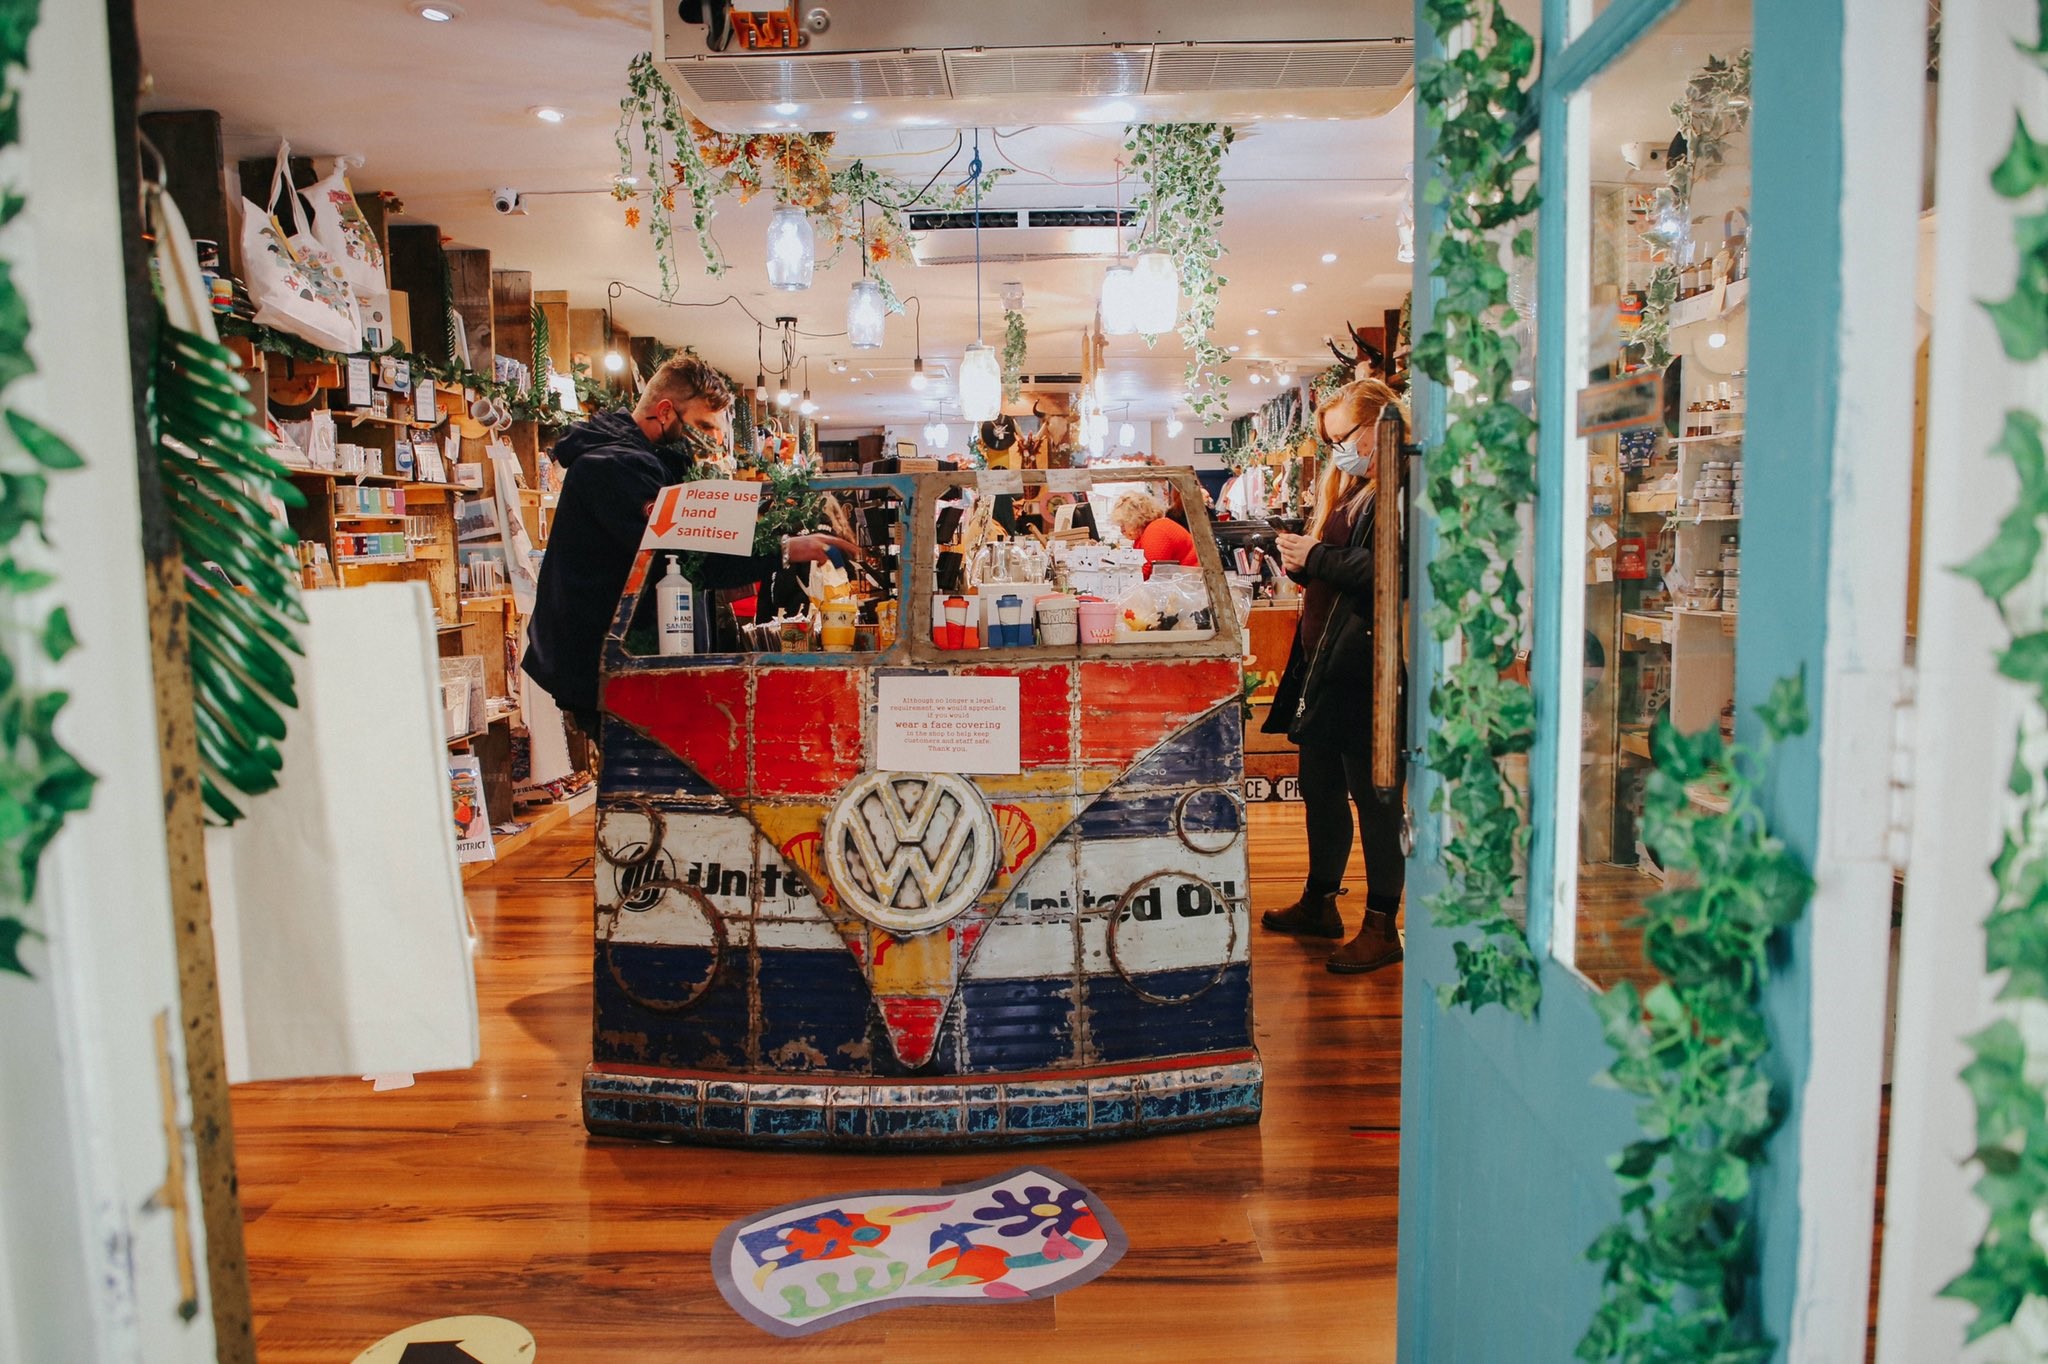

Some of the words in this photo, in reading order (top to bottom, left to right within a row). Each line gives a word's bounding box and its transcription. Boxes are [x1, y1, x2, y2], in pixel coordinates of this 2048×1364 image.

[686, 489, 730, 501] Please
[734, 492, 758, 503] use
[681, 507, 717, 519] hand
[677, 526, 739, 540] sanitiser
[902, 697, 934, 705] Although
[945, 697, 968, 705] longer
[975, 697, 994, 705] legal
[930, 721, 953, 729] face
[955, 721, 1001, 730] covering
[838, 777, 984, 912] VW
[688, 860, 810, 898] Unte
[1176, 880, 1235, 918] Oil
